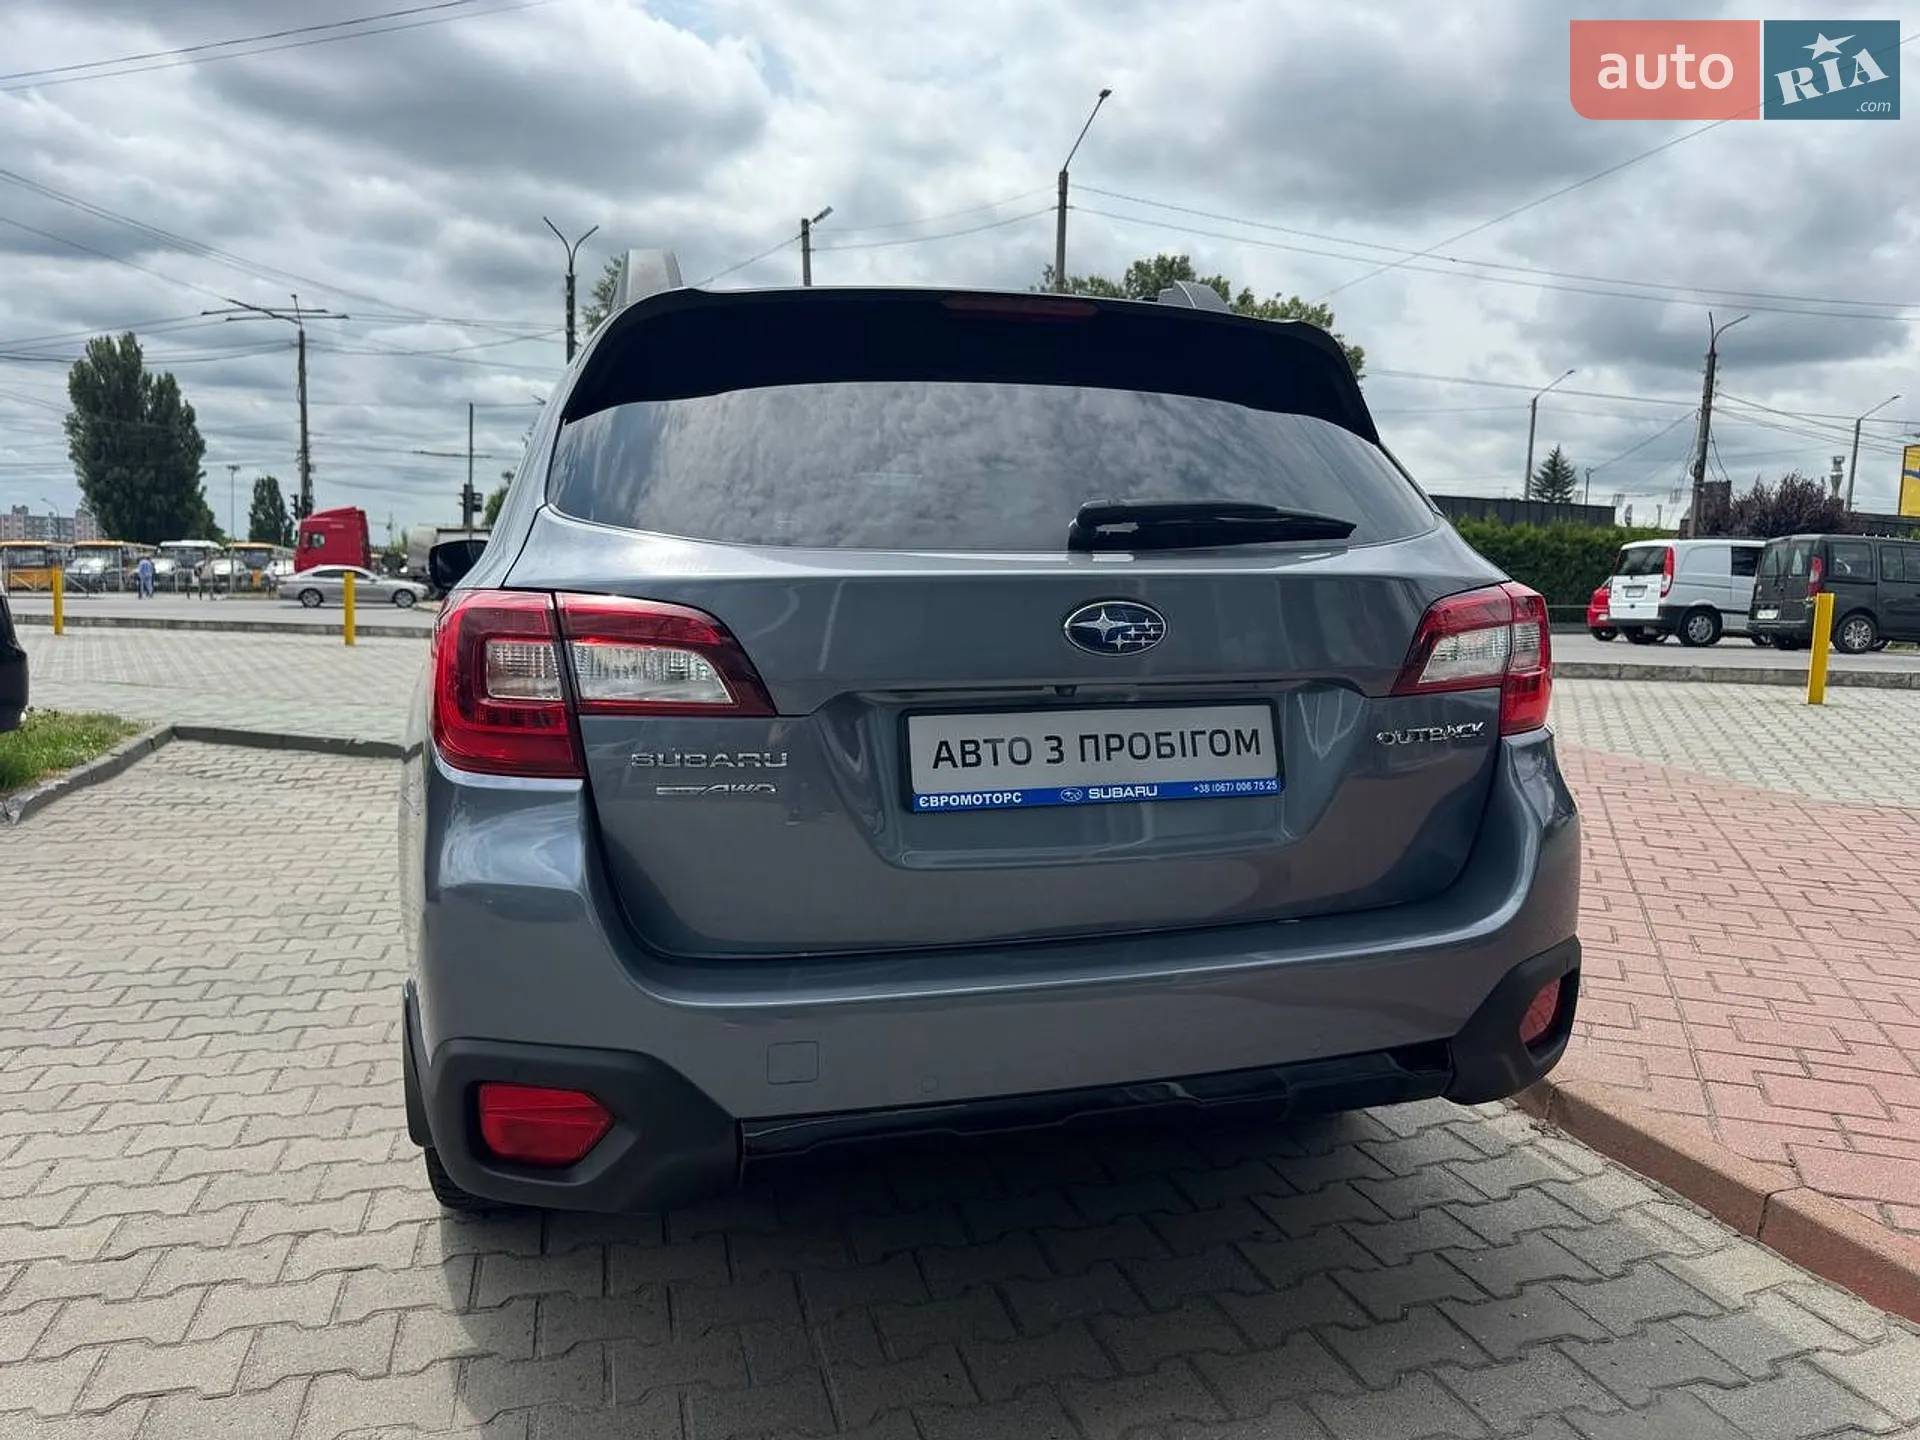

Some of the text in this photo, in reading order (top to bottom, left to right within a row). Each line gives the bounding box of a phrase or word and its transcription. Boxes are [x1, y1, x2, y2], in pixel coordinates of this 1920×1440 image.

[1376, 721, 1485, 746] OUTBACK
[932, 727, 1262, 770] АВТО З ПРОБІГОМ
[631, 751, 788, 769] SUBARU
[1088, 785, 1158, 800] SUBARU
[1265, 780, 1278, 790] 25
[919, 791, 1022, 807] ЄВРОМОТОРС
